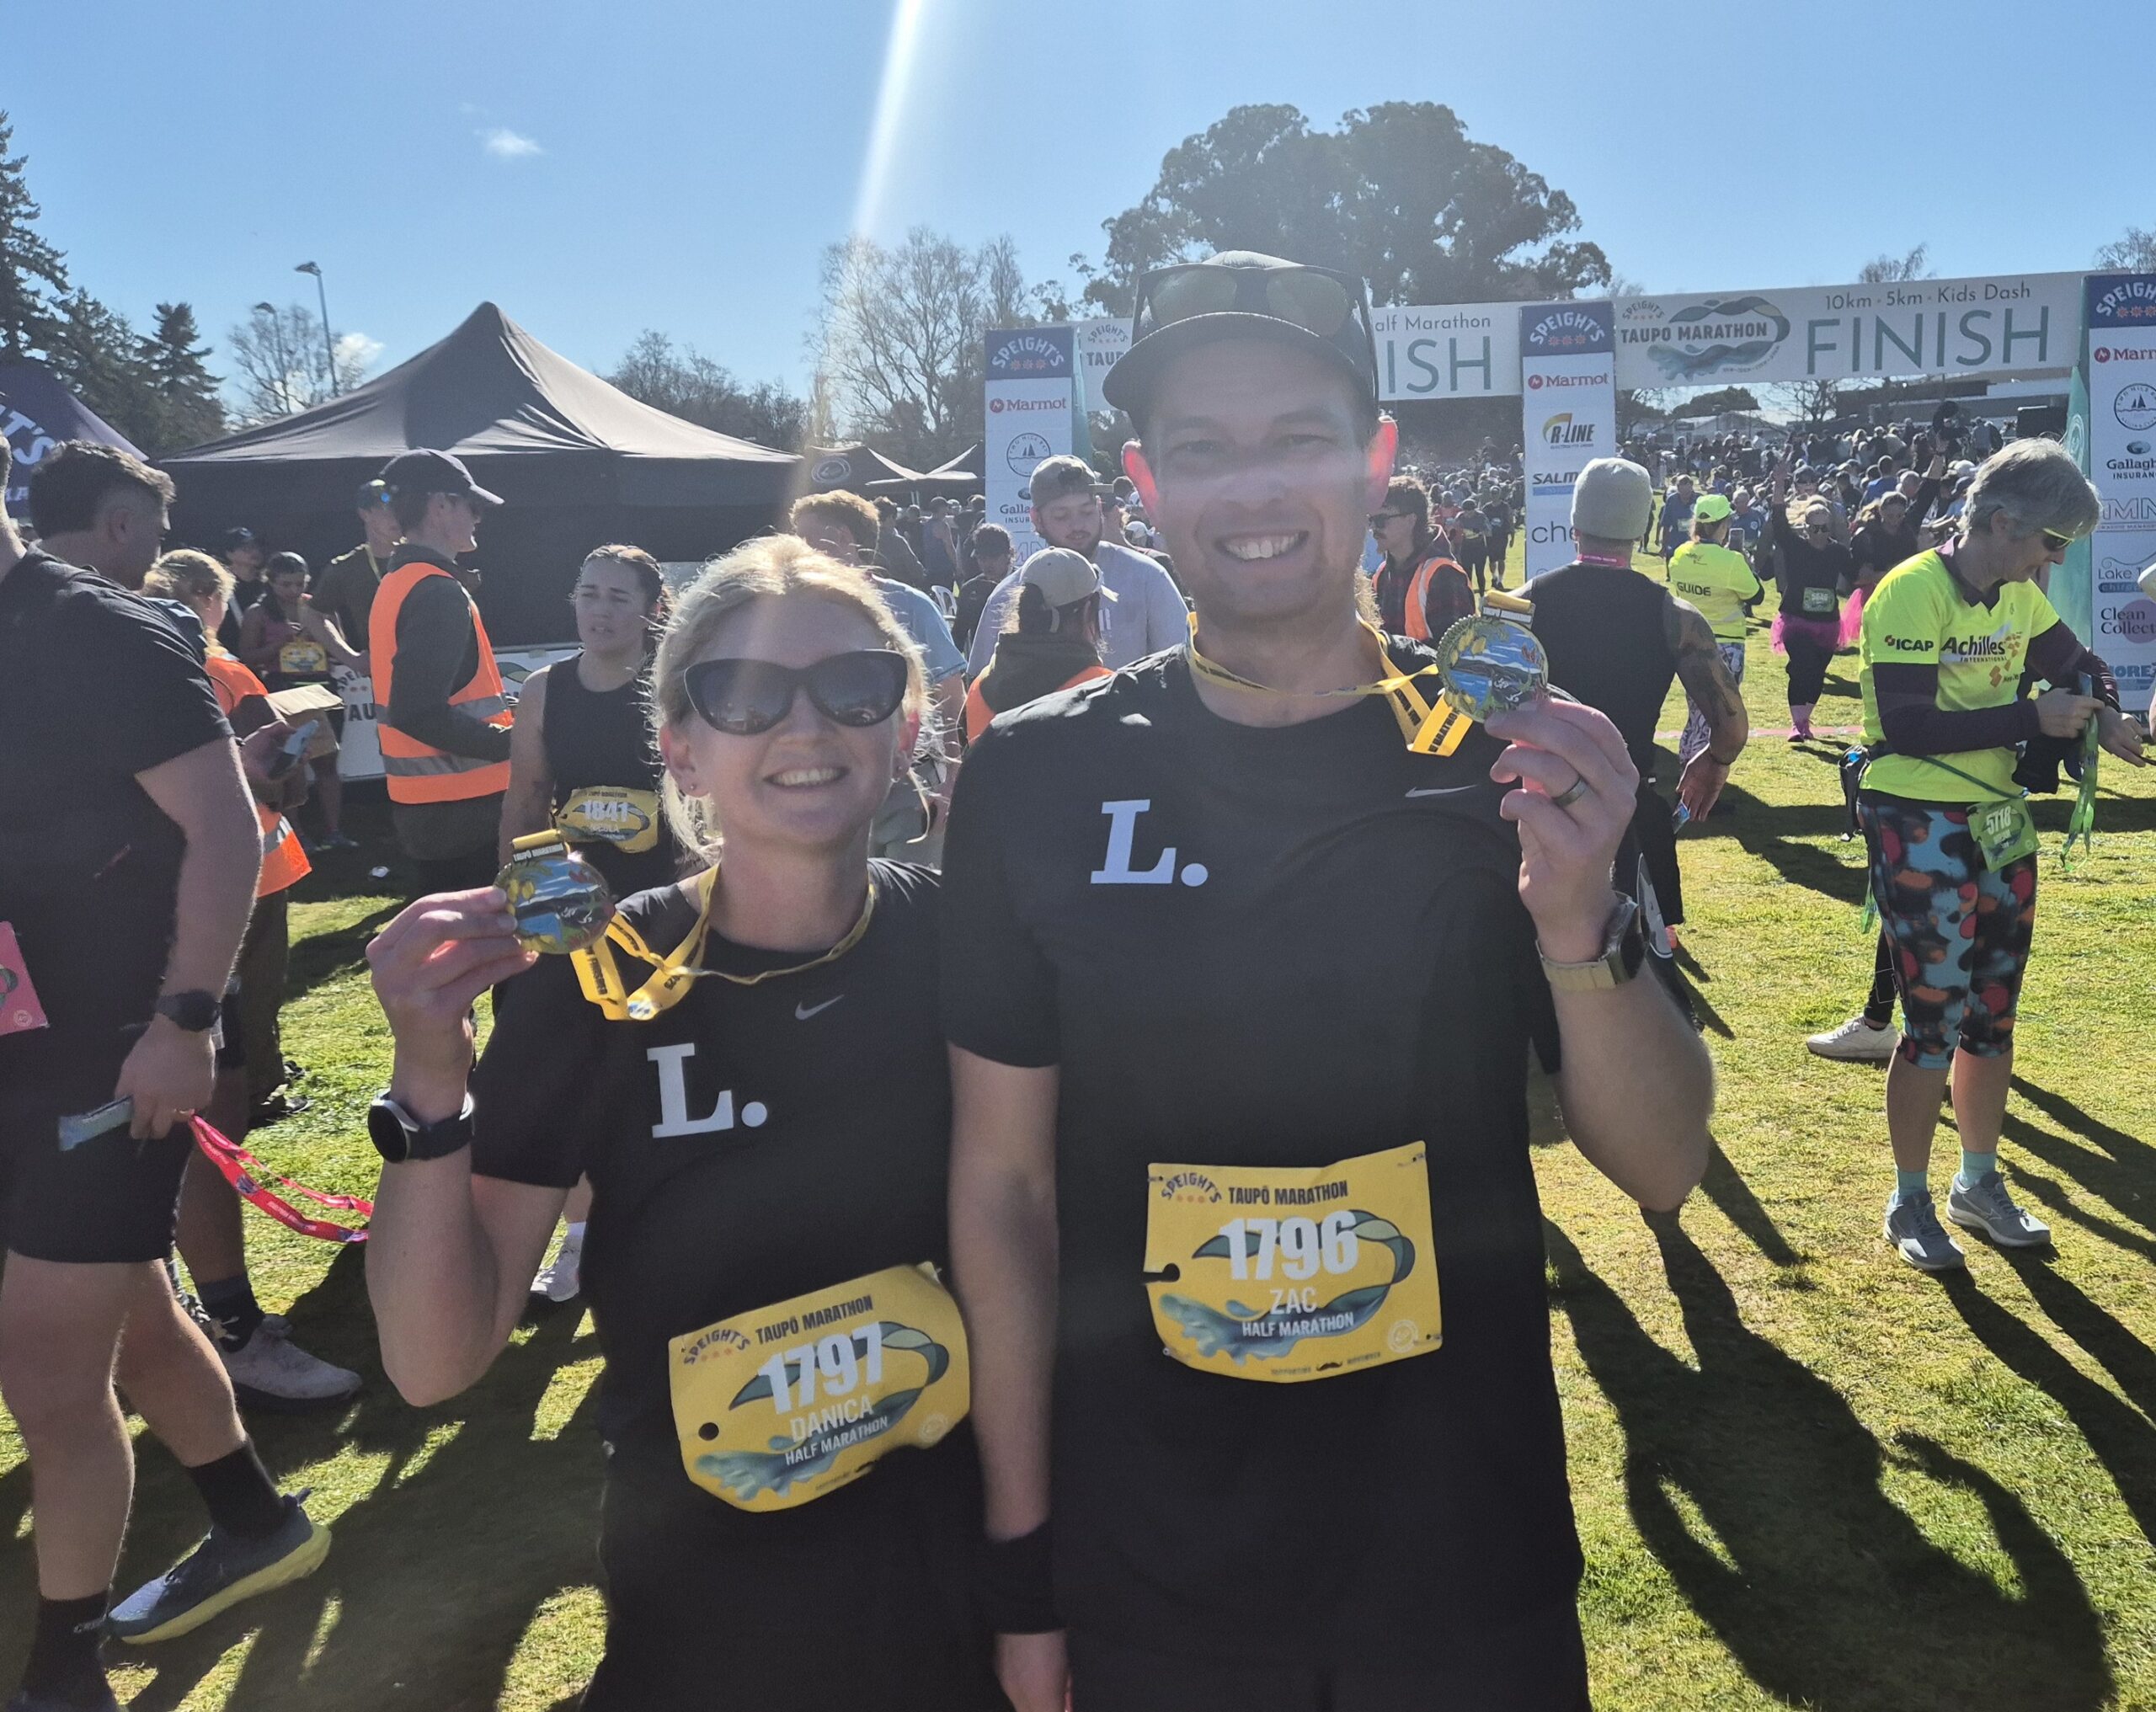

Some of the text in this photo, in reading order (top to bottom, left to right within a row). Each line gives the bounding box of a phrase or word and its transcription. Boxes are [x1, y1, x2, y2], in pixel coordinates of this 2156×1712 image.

[1825, 280, 2031, 311] 10km 5km Kids Dash
[1374, 312, 1492, 332] alf Marathon
[1621, 300, 1665, 322] SPEIGHT'S
[1087, 323, 1129, 344] SPEIGHT'S
[1529, 312, 1606, 344] SPEIGHT'S
[1620, 322, 1768, 344] TAUPO MARATHON
[1806, 305, 2049, 376] FINISH
[991, 336, 1065, 369] SPEIGHT'S
[1386, 335, 1492, 394] ISH
[1545, 371, 1609, 387] Marmot
[1006, 397, 1066, 411] Marmot
[1550, 421, 1595, 445] R-LINE
[2112, 471, 2156, 480] INSURAN
[2098, 568, 2132, 580] Lake
[1676, 581, 1712, 597] GUIDE
[2100, 606, 2146, 621] Clean
[1896, 638, 1935, 652] ICAP
[1940, 634, 2006, 655] Achilles
[1959, 655, 2008, 664] INTERNATIONAL
[584, 799, 629, 823] 1841
[1986, 805, 2012, 836] 5718
[1090, 798, 1209, 888] L.
[646, 1042, 768, 1139] L.
[1161, 1172, 1223, 1204] SPEIGHT'S
[1273, 1180, 1349, 1206] MARATHON
[1219, 1209, 1360, 1282] 1796
[802, 1294, 873, 1331] MARATHON
[1269, 1287, 1319, 1316] ZAC
[1241, 1311, 1355, 1338] HALF MARATHON
[683, 1328, 751, 1366] SPEIGHT'S
[757, 1321, 884, 1416] 1797
[789, 1394, 875, 1444] DANICA
[784, 1416, 889, 1466] HALF MARATHON
